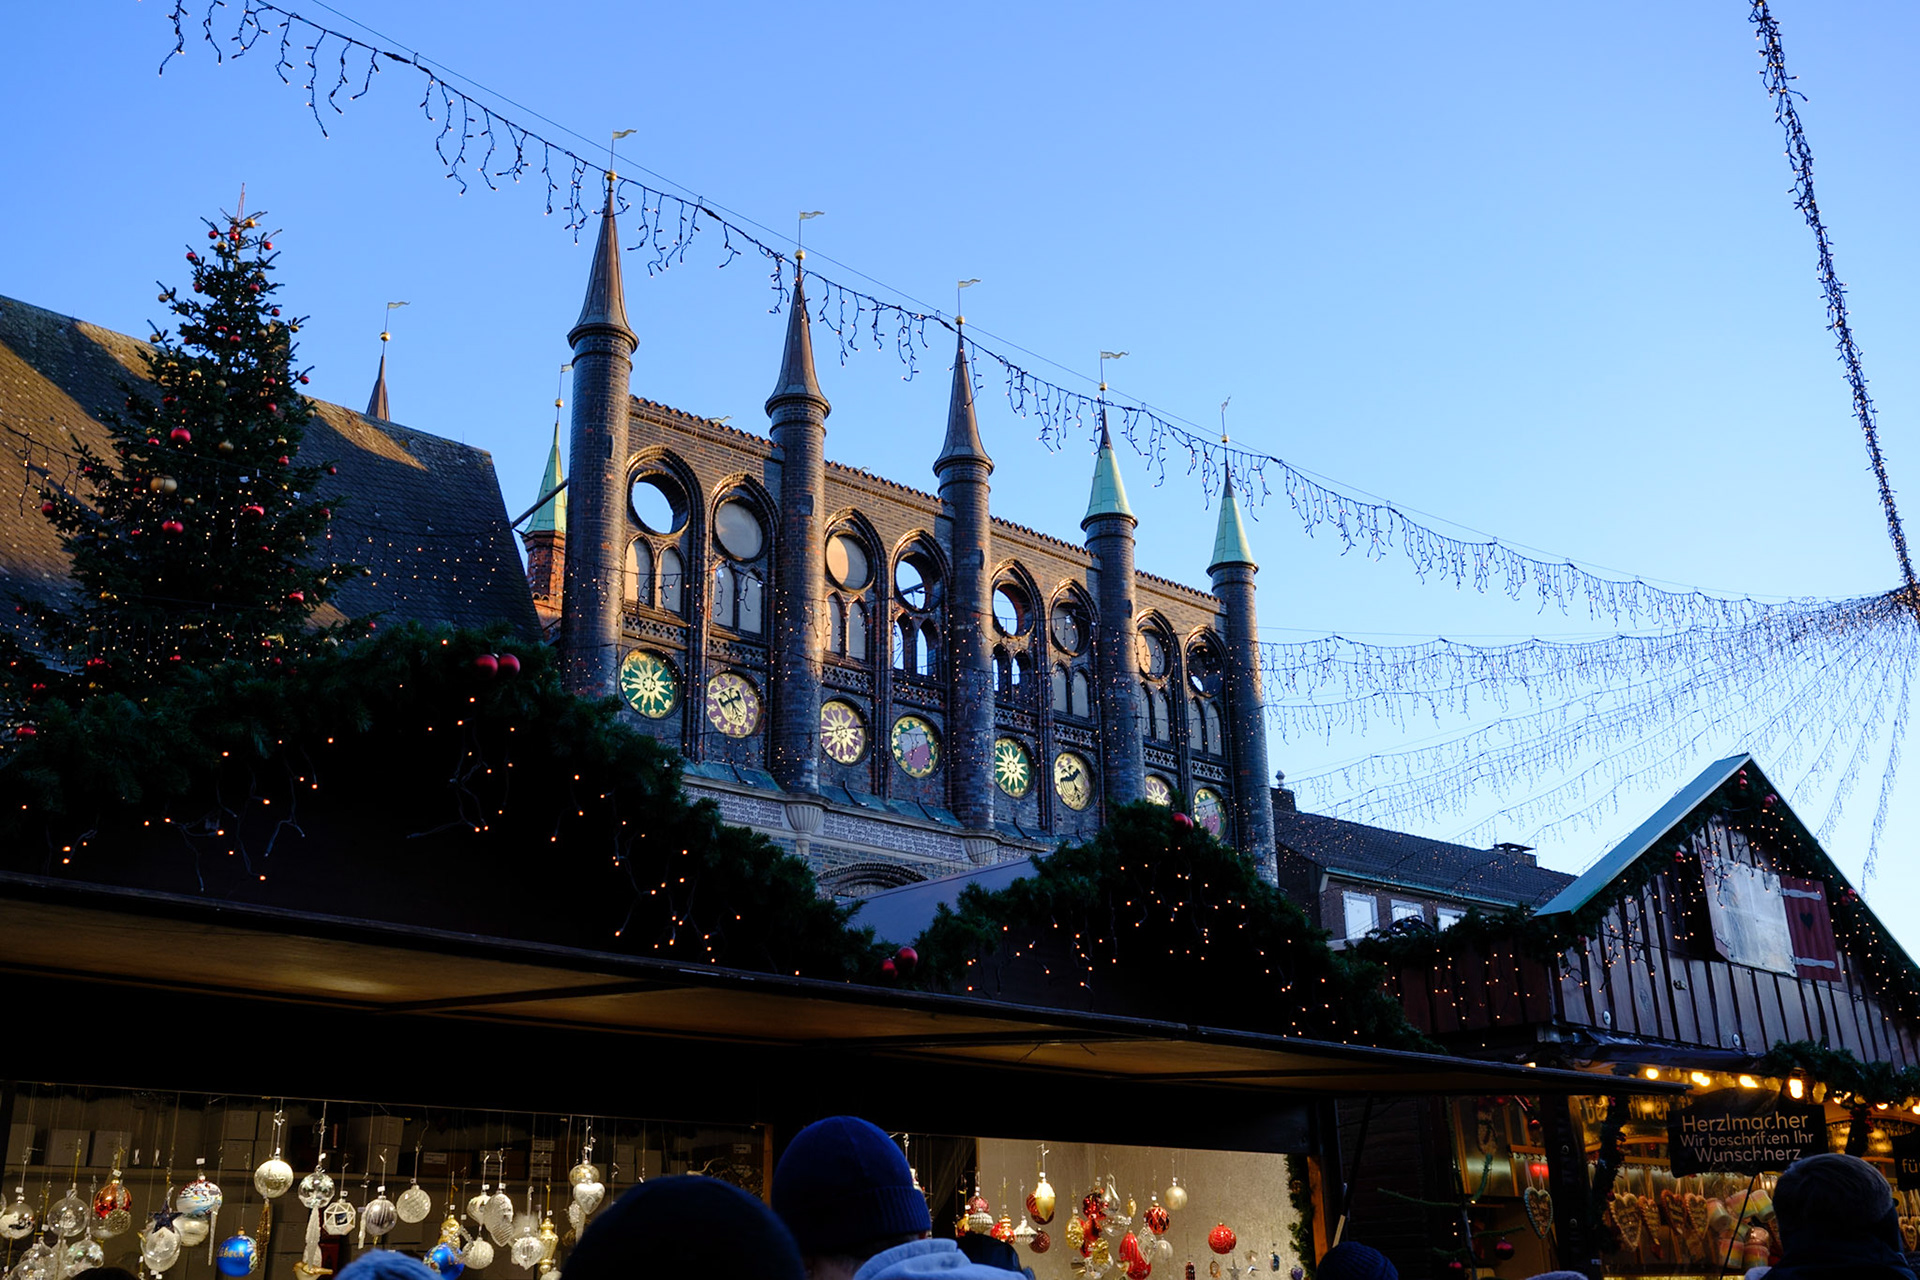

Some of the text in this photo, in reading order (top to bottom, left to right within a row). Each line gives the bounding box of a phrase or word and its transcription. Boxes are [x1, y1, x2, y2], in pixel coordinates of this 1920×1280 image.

[1681, 1111, 1809, 1133] Herzlmacher
[1680, 1134, 1705, 1148] Wir
[1794, 1130, 1814, 1144] Ihr
[1694, 1146, 1803, 1163] Wunschherz
[1901, 1158, 1920, 1174] fü
